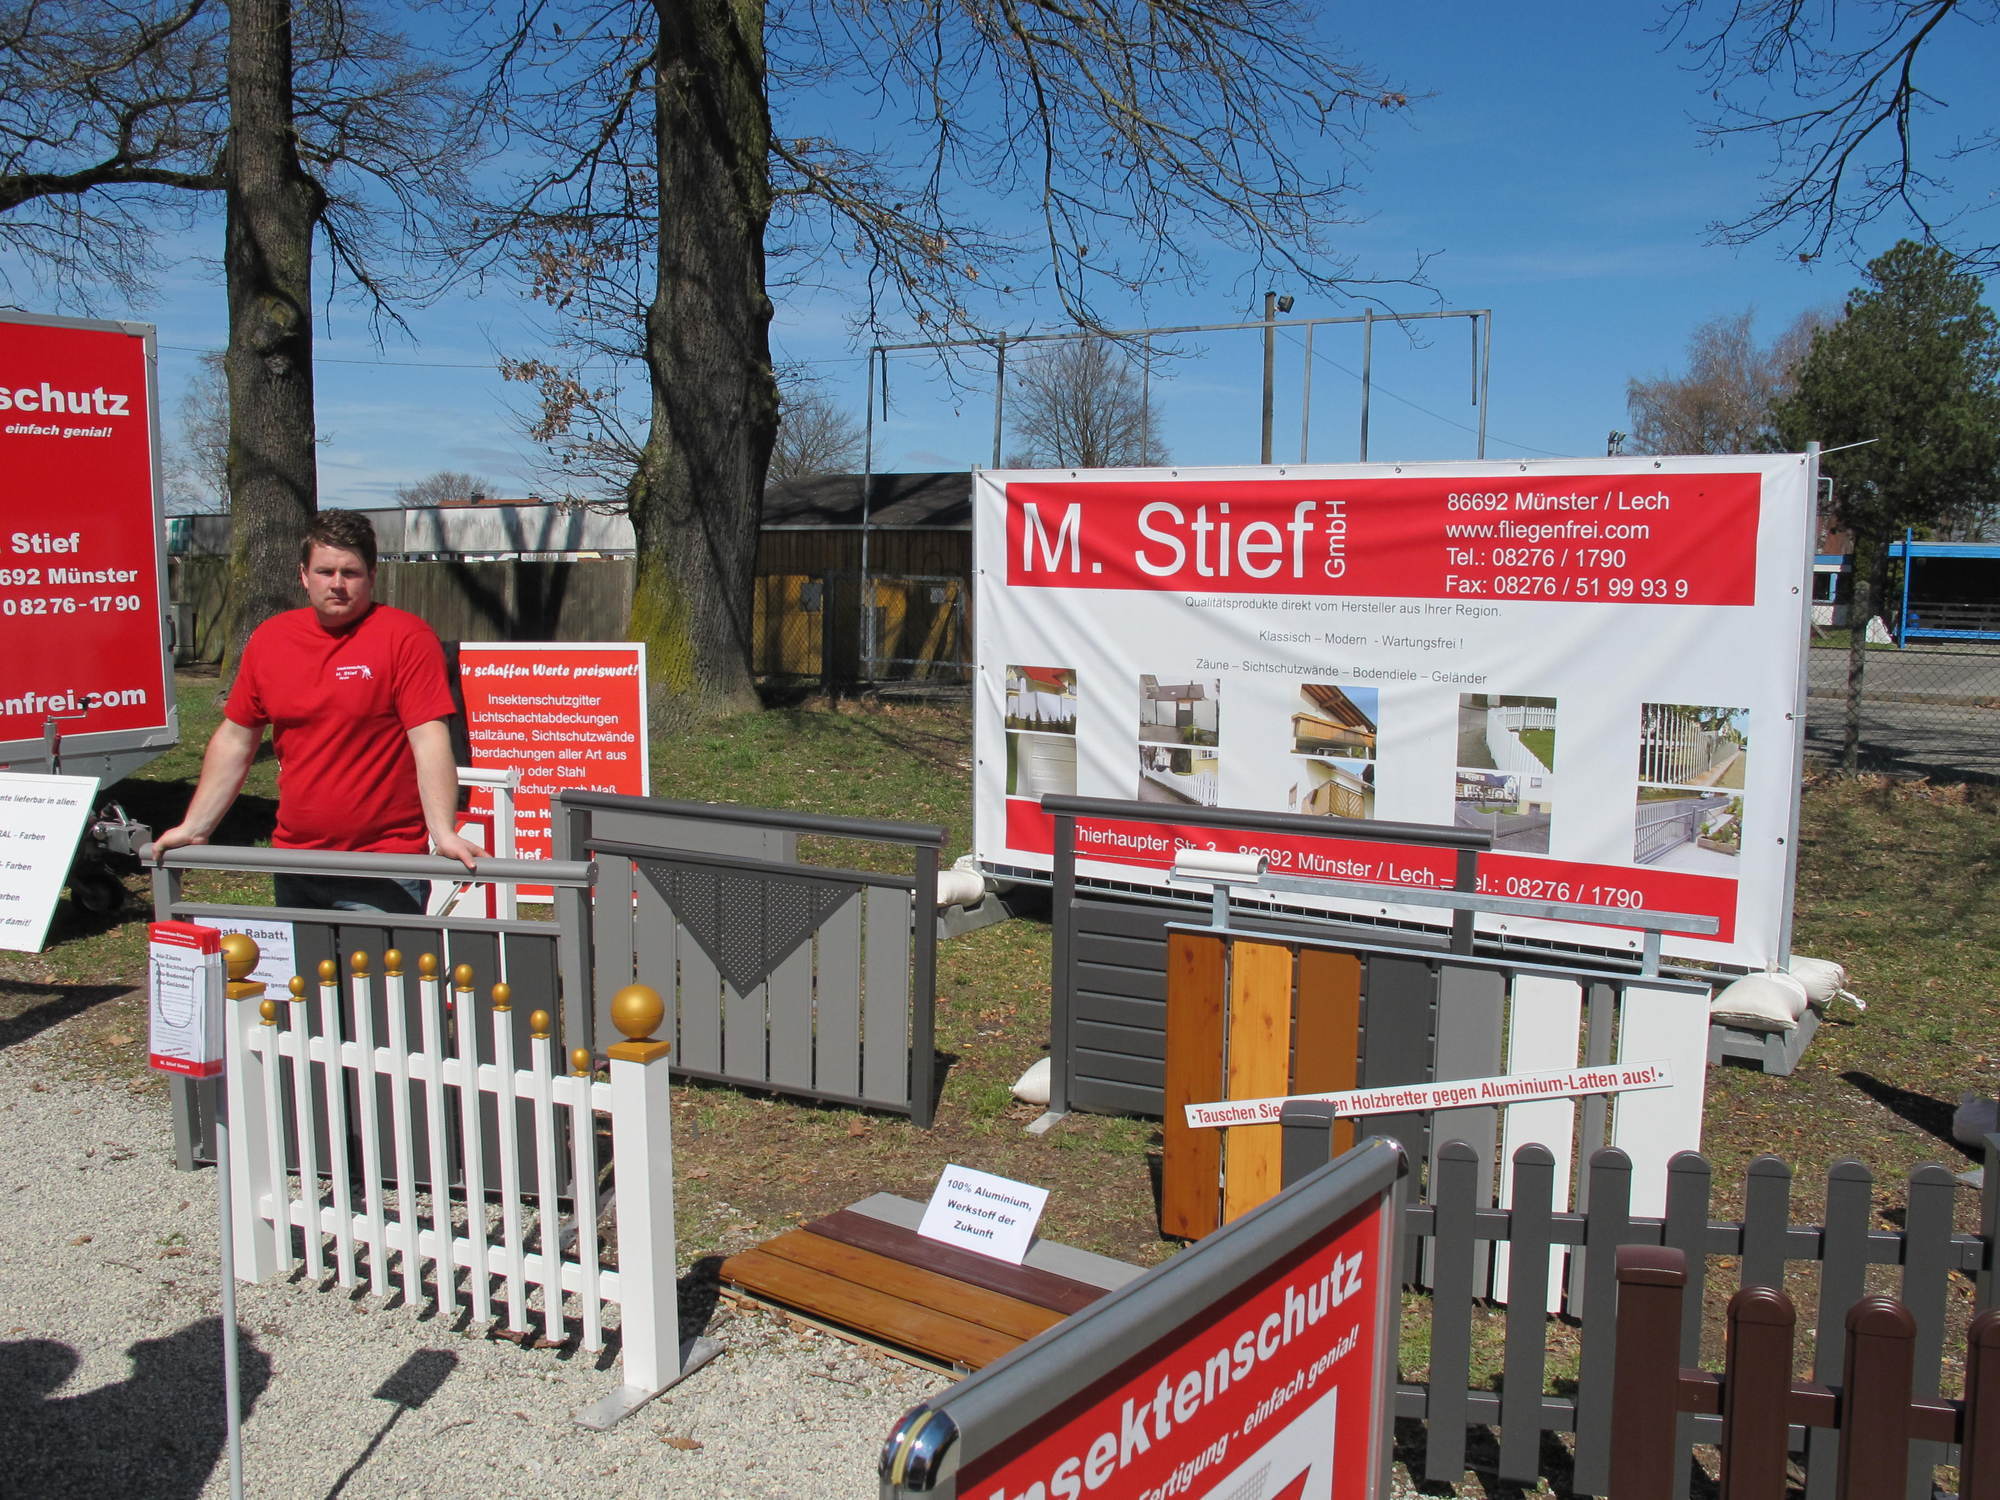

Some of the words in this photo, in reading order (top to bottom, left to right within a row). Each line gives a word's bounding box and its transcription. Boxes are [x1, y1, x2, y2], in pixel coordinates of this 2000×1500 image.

[5, 423, 60, 436] einfach
[63, 426, 113, 439] genial!
[1447, 493, 1509, 511] 86692
[1514, 491, 1599, 511] Münster
[1604, 491, 1612, 510] /
[1618, 491, 1670, 510] Lech
[1022, 502, 1103, 574] M.
[1134, 500, 1317, 579] Stief
[1324, 499, 1347, 579] GmbH
[1445, 520, 1650, 543] www.fliegenfrei.com
[11, 532, 81, 554] Stief
[1446, 547, 1486, 566] Tel.:
[1492, 548, 1555, 567] 08276
[1560, 548, 1569, 567] /
[1575, 549, 1627, 568] 1790
[48, 567, 139, 584] Münster
[1445, 575, 1488, 594] Fax:
[1493, 576, 1557, 595] 08276
[1562, 577, 1570, 595] /
[1576, 577, 1600, 596] 51
[1608, 578, 1634, 597] 99
[1640, 579, 1668, 598] 93
[1675, 579, 1689, 598] 9
[1281, 601, 1312, 612] direkt
[1315, 603, 1338, 612] vom
[1341, 602, 1396, 614] Hersteller
[1399, 604, 1421, 615] aus
[1424, 603, 1452, 616] Ihrer
[1455, 604, 1502, 619] Region.
[1259, 630, 1311, 644] Klassisch
[1324, 633, 1367, 646] Modern
[1382, 635, 1457, 651] Wartungsfrei
[460, 664, 471, 676] ir
[474, 663, 530, 679] schaffen
[532, 664, 570, 676] Werte
[573, 664, 639, 679] preiswert!
[1196, 658, 1229, 670] Zäune
[1242, 661, 1339, 677] Sichtschutzwände
[1352, 666, 1417, 681] Bodendiele
[1431, 671, 1487, 685] Geländer
[0, 688, 147, 716] nfrei.com
[488, 693, 602, 708] Insektenschutzgitter
[472, 711, 619, 726] Lichtschachtabdeckungen
[469, 729, 528, 742] etallzäune,
[531, 730, 635, 743] Sichtschutzwände
[558, 748, 583, 760] aller
[585, 748, 603, 760] Art
[606, 751, 627, 760] aus
[528, 766, 554, 777] oder
[556, 765, 586, 777] Stahl
[14, 794, 46, 804] lieferbar
[19, 831, 46, 841] Farben
[515, 827, 541, 838] hrer
[5, 861, 32, 871] Farben
[1297, 852, 1372, 878] Münster
[1376, 862, 1384, 879] /
[1389, 862, 1435, 886] Lech
[1475, 874, 1499, 893] el.:
[1506, 876, 1570, 900] 08276
[1576, 884, 1585, 903] /
[1591, 886, 1644, 910] 1790
[5, 916, 32, 927] damit!
[245, 928, 289, 942] Rabatt,
[1196, 1106, 1257, 1124] Tauschen
[1260, 1103, 1280, 1118] Sie
[1352, 1092, 1428, 1112] Holzbretter
[1432, 1087, 1478, 1106] gegen
[1481, 1070, 1618, 1098] Aluminium-Latten
[1622, 1066, 1657, 1085] aus!
[947, 1178, 973, 1193] 100%
[974, 1186, 1032, 1212] Aluminium,
[947, 1199, 998, 1221] Werkstoff
[997, 1214, 1017, 1226] der
[953, 1220, 994, 1240] Zukunft
[988, 1250, 1364, 1500] sektenschutz
[1243, 1368, 1305, 1436] einfach
[1307, 1323, 1360, 1390] genial!
